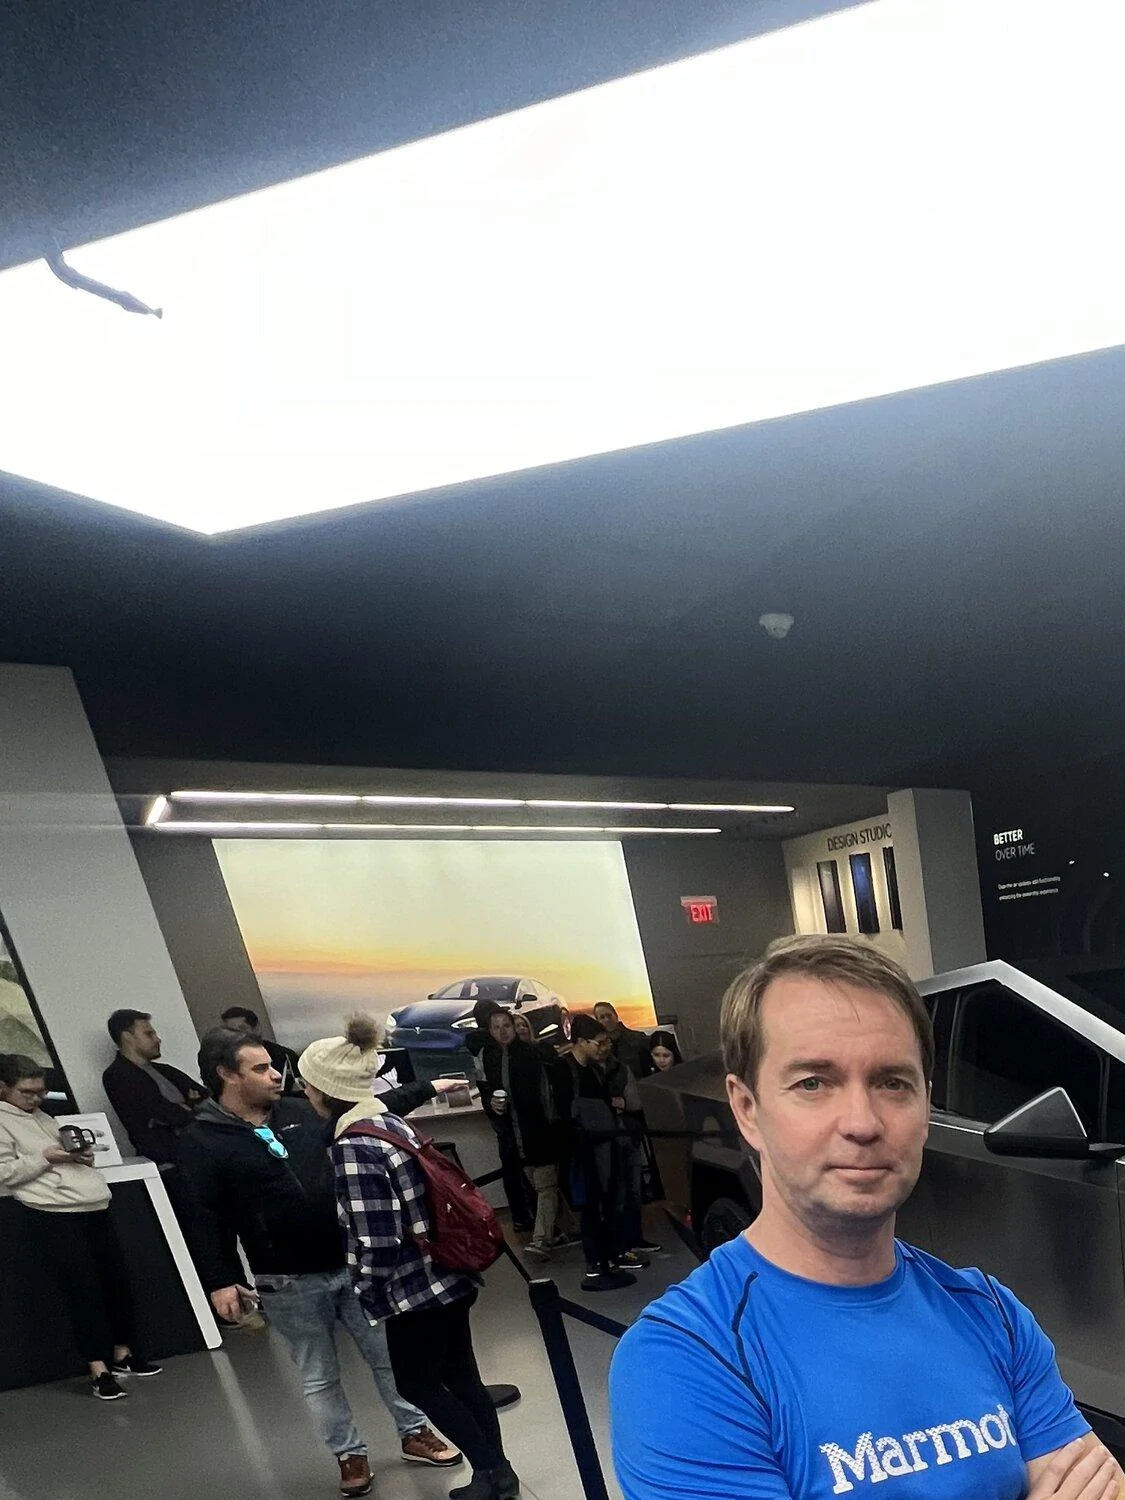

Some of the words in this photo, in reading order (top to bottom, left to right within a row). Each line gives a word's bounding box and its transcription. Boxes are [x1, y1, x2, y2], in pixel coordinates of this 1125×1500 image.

[827, 832, 858, 852] DESIGN
[994, 829, 1023, 845] BETTER
[995, 846, 1016, 861] OVER
[1018, 842, 1036, 856] TIME
[690, 904, 713, 922] EXIT
